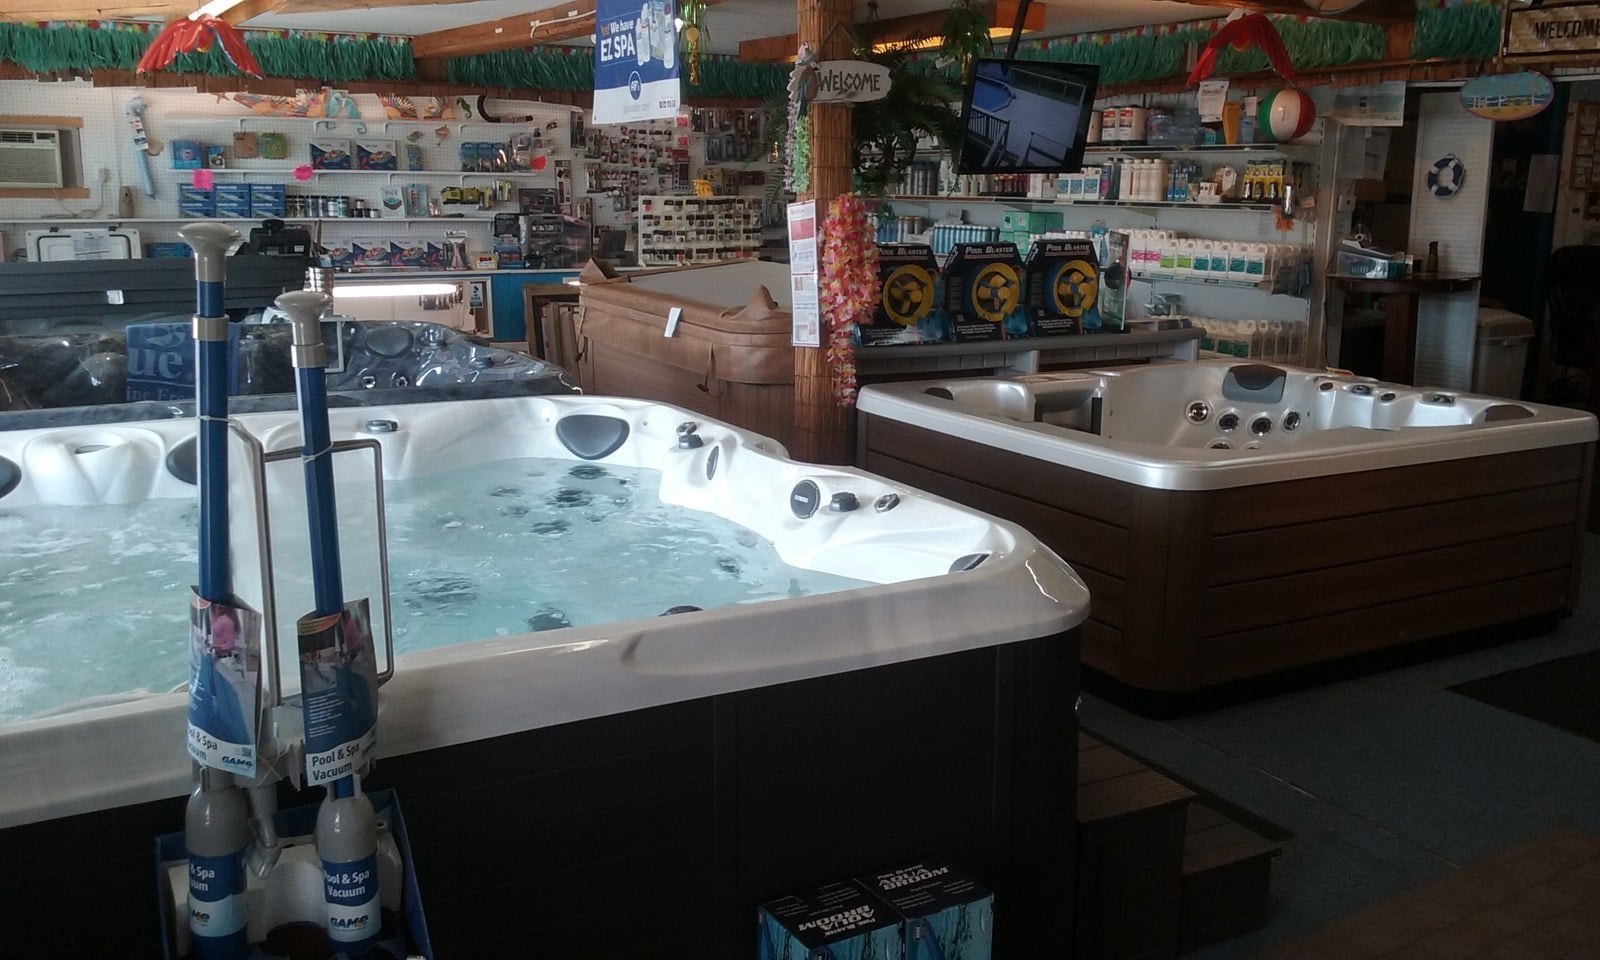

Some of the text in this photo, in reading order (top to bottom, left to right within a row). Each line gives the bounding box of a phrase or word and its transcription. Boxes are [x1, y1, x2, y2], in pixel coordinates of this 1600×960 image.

[610, 22, 619, 34] We
[620, 19, 634, 32] have
[600, 32, 636, 62] EZ SPA
[816, 69, 881, 92] WELCOME
[202, 735, 218, 751] Spa
[312, 743, 360, 767] Pool & Spa
[312, 762, 353, 781] Vacuum
[196, 866, 216, 880] Spa
[341, 873, 351, 885] &
[352, 870, 370, 884] Spa
[327, 884, 366, 898] Vacuum
